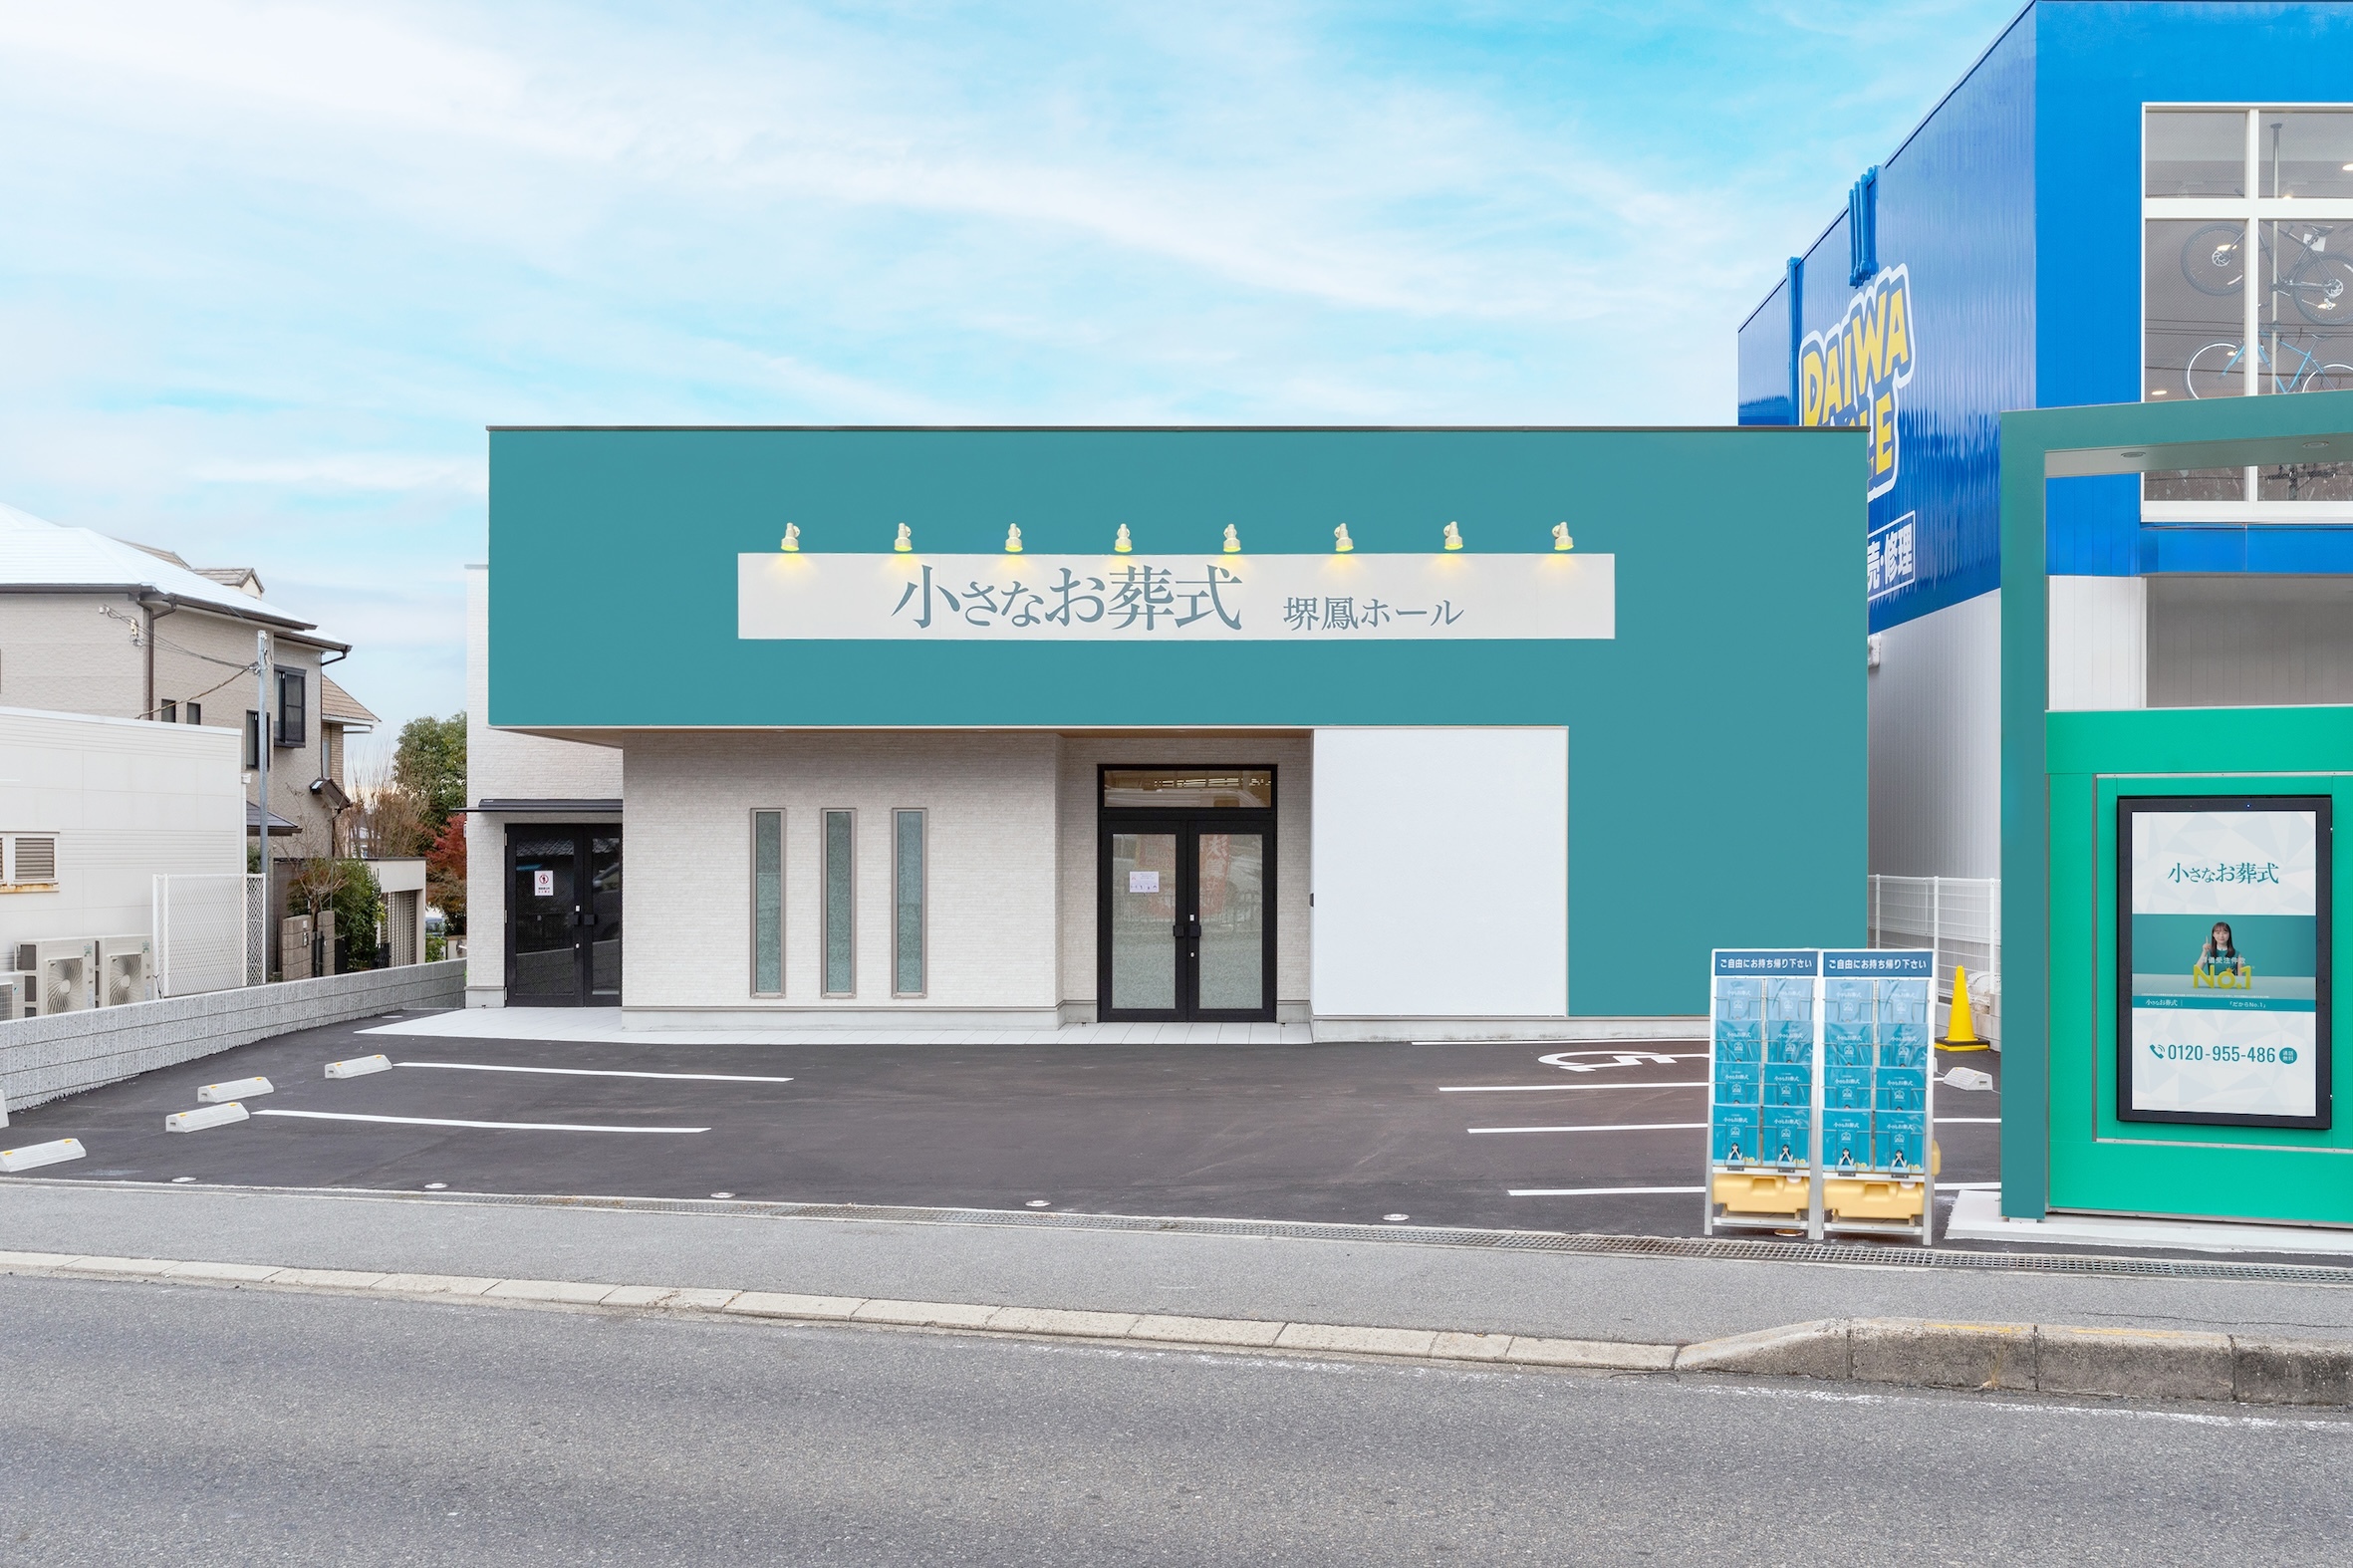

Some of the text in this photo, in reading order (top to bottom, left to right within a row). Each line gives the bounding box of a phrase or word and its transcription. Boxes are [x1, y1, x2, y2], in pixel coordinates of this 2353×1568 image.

[1801, 287, 1910, 426] DAIWA
[891, 564, 1243, 632] 小さなお葬式
[1282, 596, 1465, 632] 堺鳳ホール
[2167, 862, 2279, 885] 小さなお葬式
[1720, 958, 1813, 969] ご自由にお持ち帰り下さい
[1828, 958, 1927, 970] ご自由にお持ち帰り下さい
[2193, 964, 2251, 989] No.1
[2168, 1044, 2275, 1063] 0120-955-486
